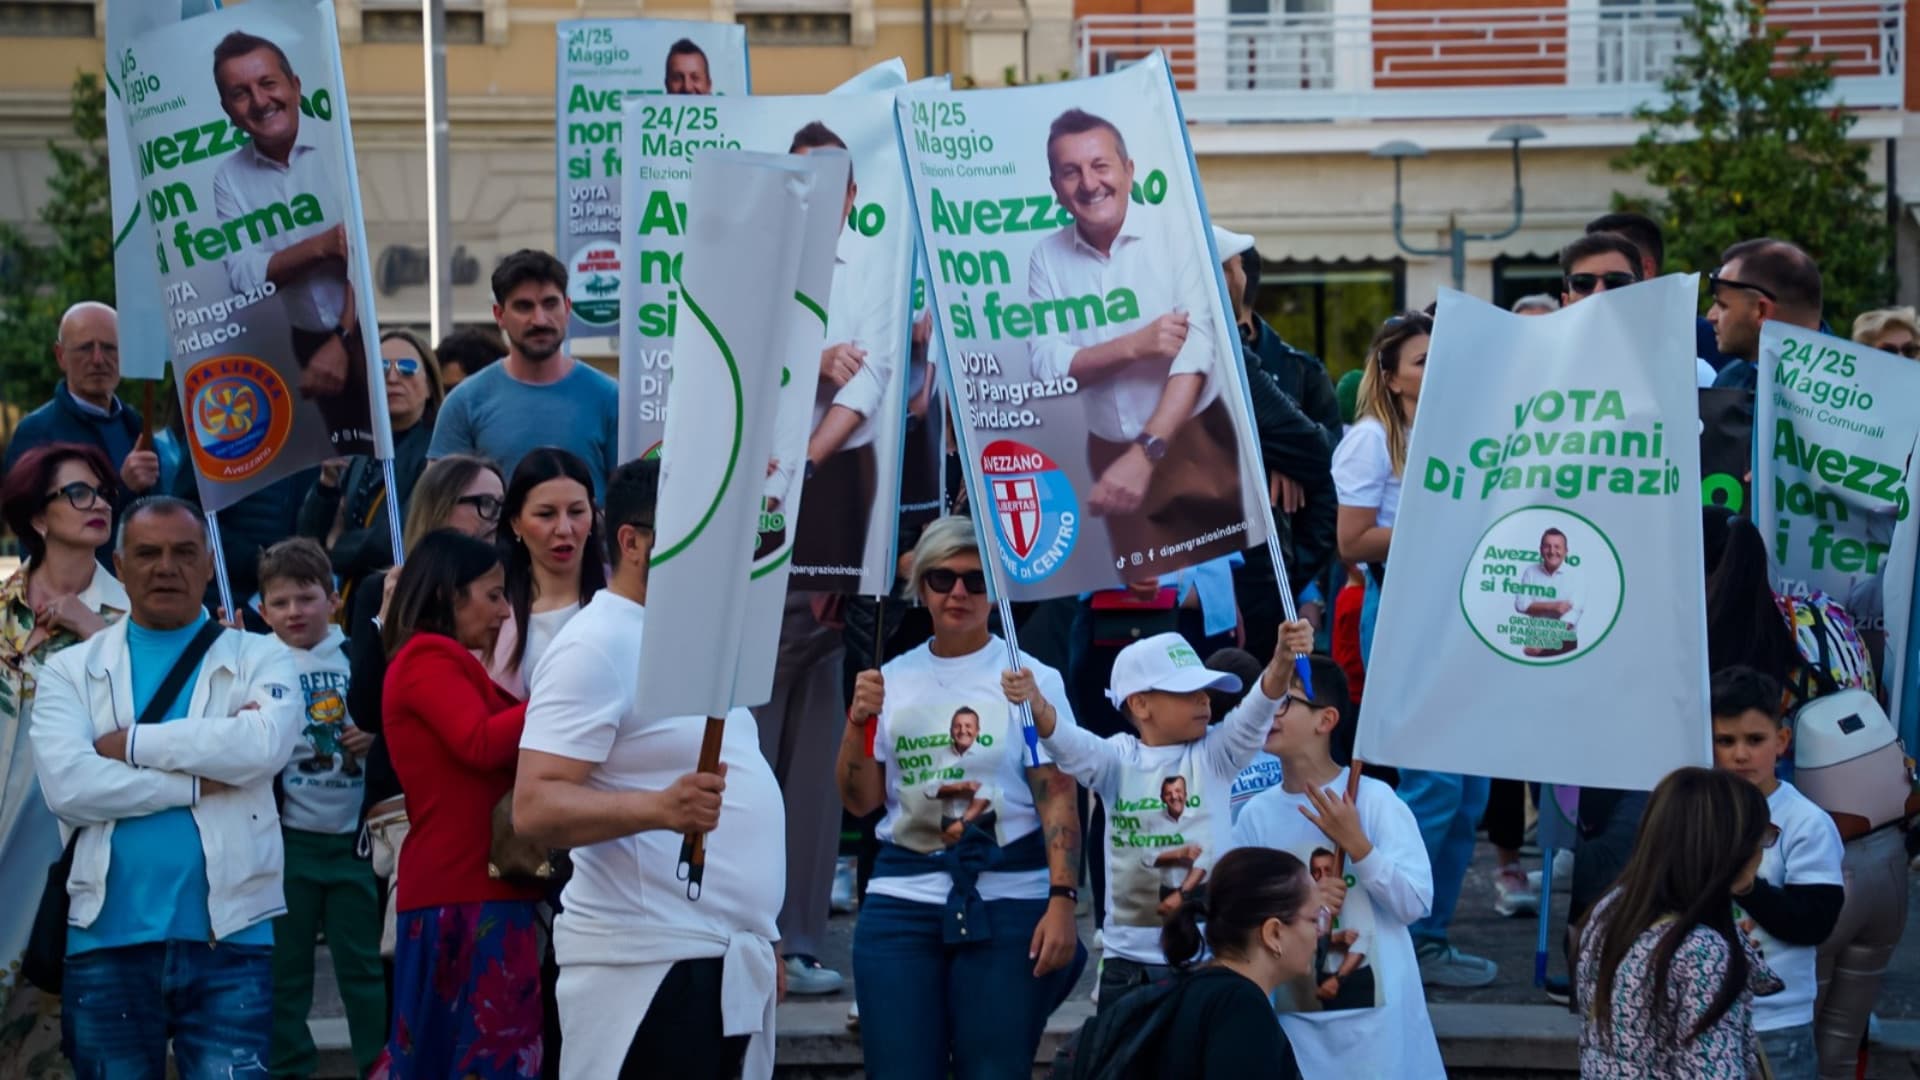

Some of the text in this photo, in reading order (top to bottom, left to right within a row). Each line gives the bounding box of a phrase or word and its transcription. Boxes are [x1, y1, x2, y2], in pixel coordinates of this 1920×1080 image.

[568, 28, 613, 47] 24/25
[567, 47, 629, 64] Maggio
[641, 106, 718, 136] 24/25
[911, 101, 966, 131] 24/25
[914, 129, 993, 160] Maggio
[567, 148, 592, 180] si
[639, 166, 692, 181] Elezioni
[957, 162, 1016, 177] Comunali
[148, 181, 198, 224] on
[569, 185, 608, 200] VOTA
[569, 202, 621, 220] Di Pang
[173, 192, 324, 268] ferma
[938, 249, 1011, 286] non
[174, 280, 277, 330] Pangrazio
[637, 290, 678, 338] si
[950, 292, 977, 340] si
[983, 287, 1140, 340] ferma
[639, 349, 672, 370] VO
[960, 352, 999, 375] VOTA
[1781, 338, 1857, 379] 24/25
[640, 375, 663, 396] Di
[965, 377, 1078, 404] Di Pangrazio
[1774, 362, 1873, 410] Maggio
[970, 408, 1041, 428] Sindaco.
[1514, 390, 1626, 430] VOTA
[1817, 408, 1884, 439] Comunali
[1469, 422, 1663, 469] Giovanni
[983, 453, 1043, 472] AVEZZANO
[1424, 456, 1465, 500] Di
[1480, 458, 1680, 500] Pangrazio
[1020, 567, 1032, 579] DI
[1032, 511, 1075, 575] CENTRO
[1484, 545, 1580, 567] Avezzo
[1808, 524, 1891, 575] fer
[1482, 563, 1517, 577] non
[1480, 577, 1557, 599] si ferma
[1497, 624, 1508, 635] DI
[1509, 615, 1567, 630] GIOVANNI
[898, 754, 932, 770] non
[1112, 814, 1141, 830] non
[1128, 831, 1184, 848] ferma
